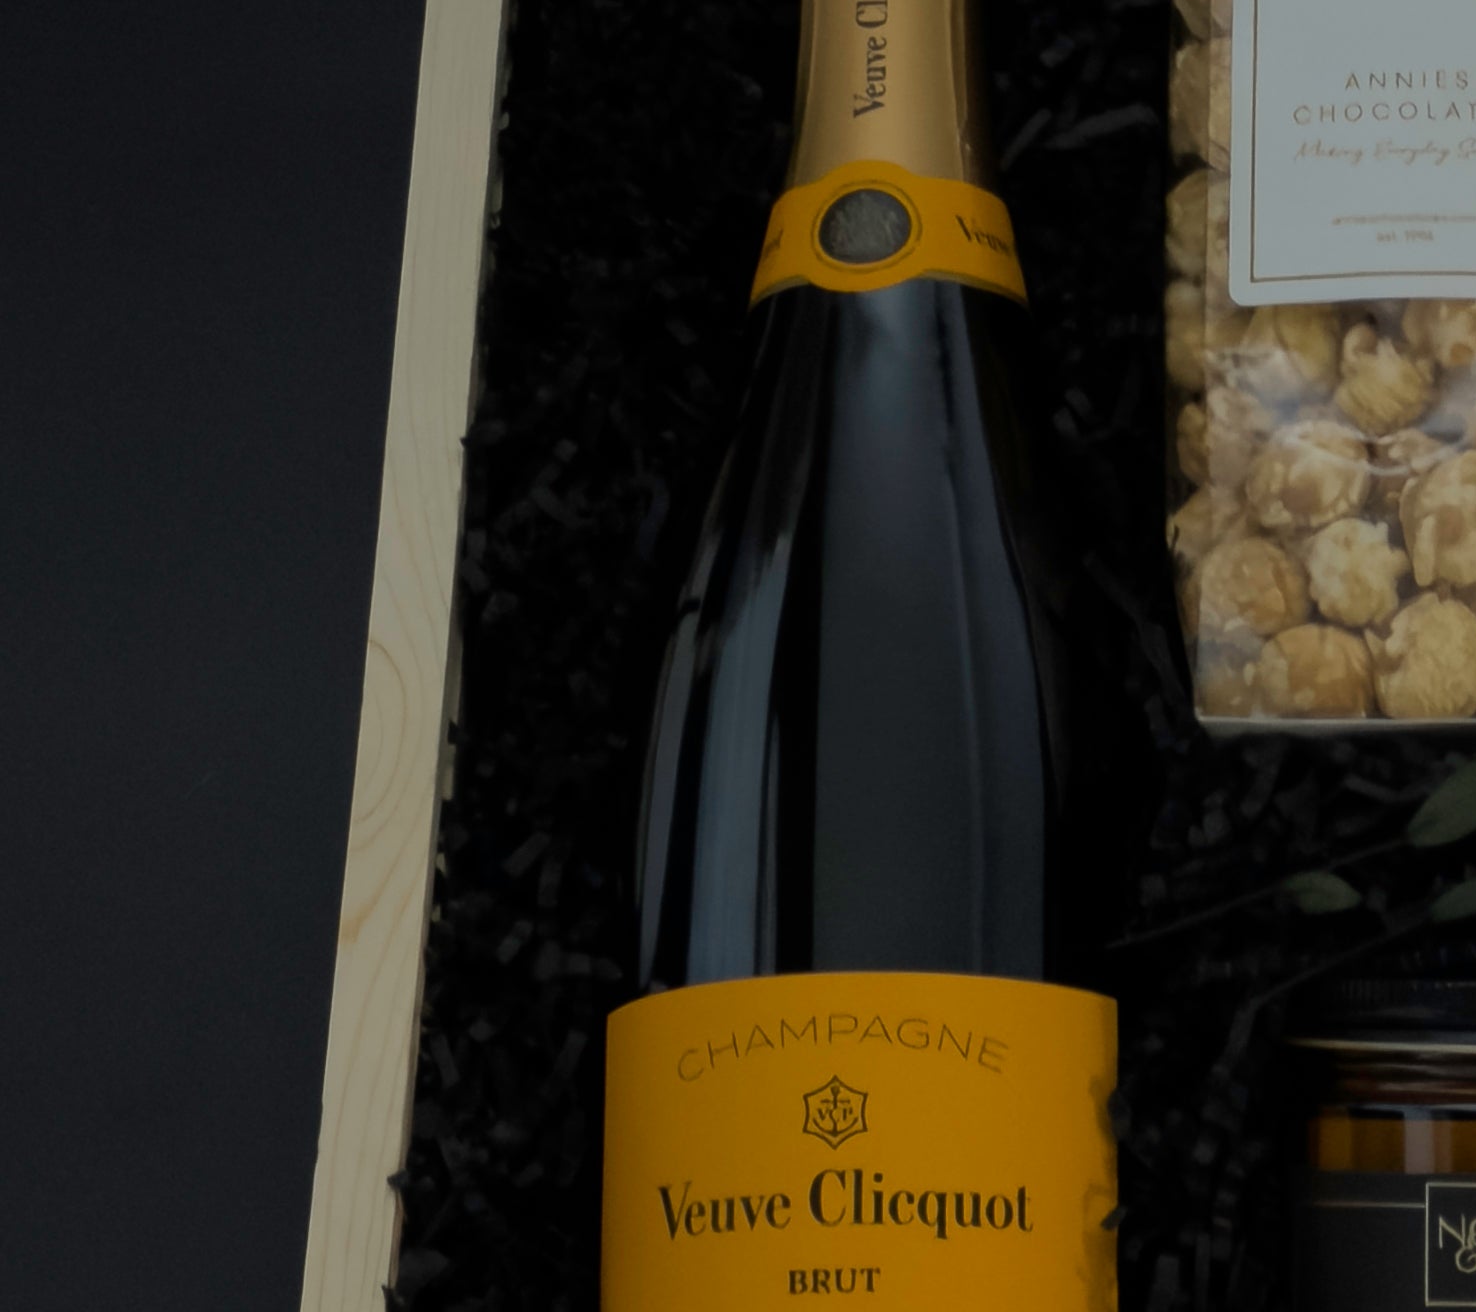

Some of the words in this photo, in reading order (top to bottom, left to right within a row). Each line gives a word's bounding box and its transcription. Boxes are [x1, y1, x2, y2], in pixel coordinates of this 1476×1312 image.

[854, 36, 887, 118] Veuve
[1344, 70, 1469, 91] ANNIES
[677, 1013, 1009, 1083] CHAMPAGNE
[658, 1180, 791, 1241] Veuve
[809, 1169, 1033, 1239] Clicquot
[788, 1267, 881, 1295] BRUT
